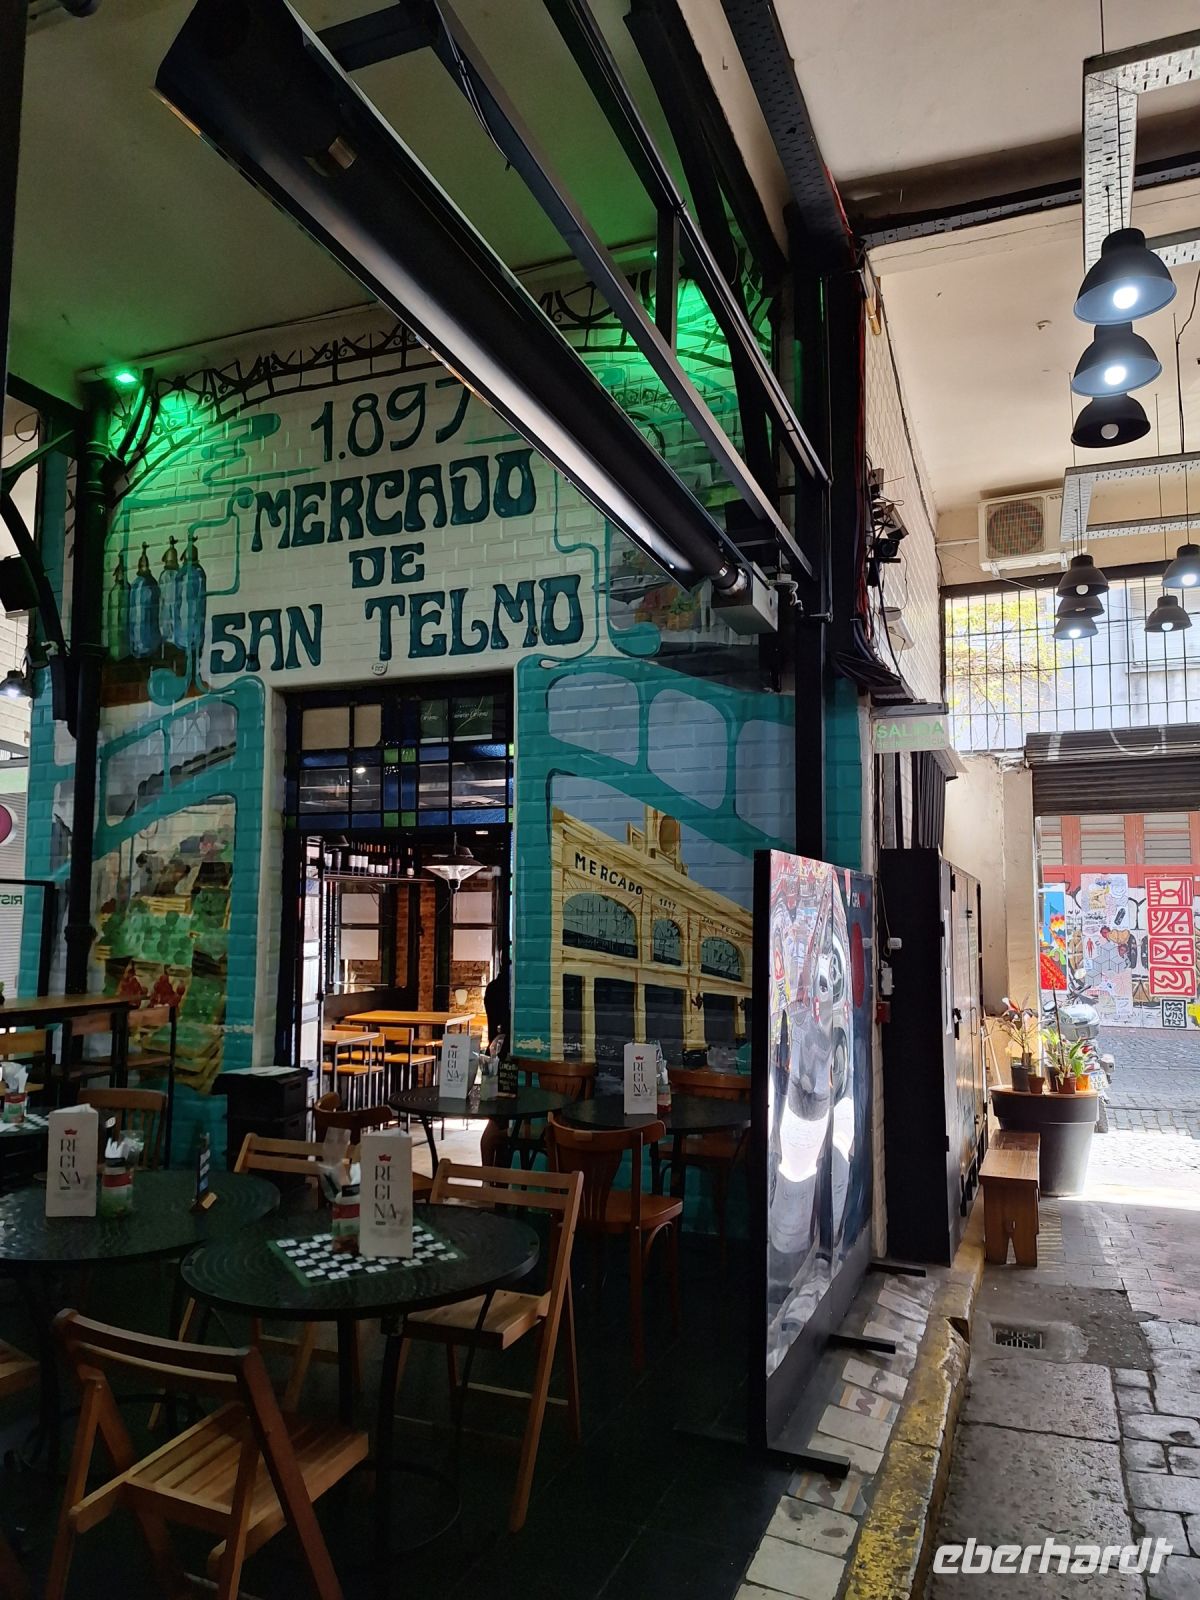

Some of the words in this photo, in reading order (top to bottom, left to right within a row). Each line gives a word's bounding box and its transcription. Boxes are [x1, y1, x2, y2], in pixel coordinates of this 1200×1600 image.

[251, 448, 536, 552] MERCADO
[349, 542, 425, 588] DE
[209, 603, 323, 674] SAN
[365, 574, 584, 661] TELMO
[876, 720, 944, 738] SALIDA
[575, 852, 643, 896] MERCADO
